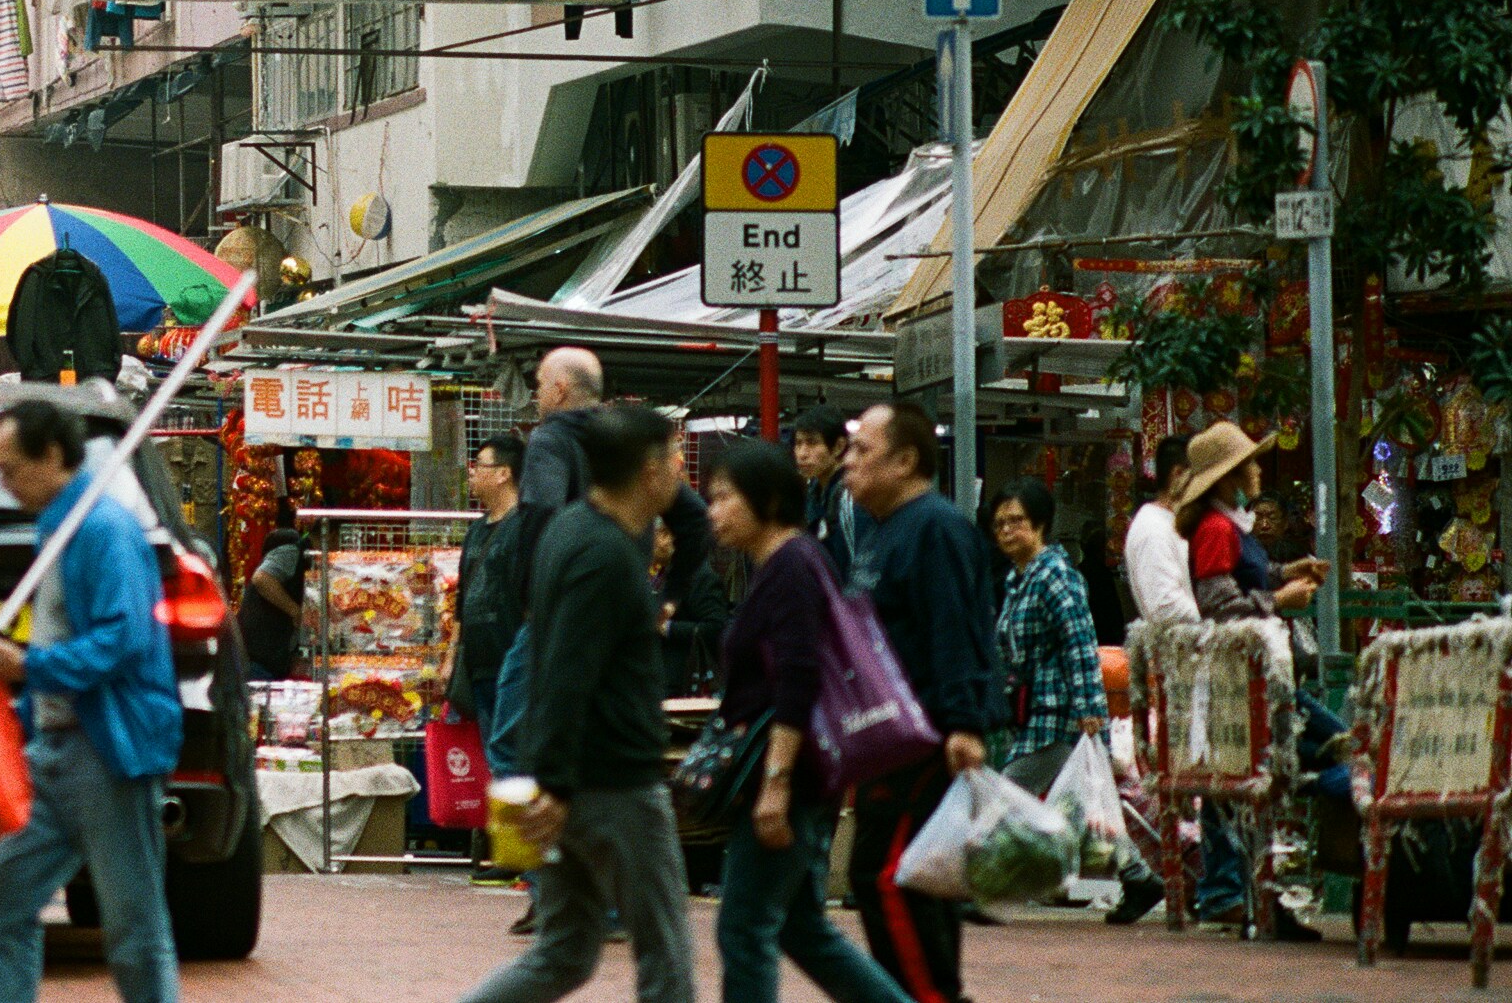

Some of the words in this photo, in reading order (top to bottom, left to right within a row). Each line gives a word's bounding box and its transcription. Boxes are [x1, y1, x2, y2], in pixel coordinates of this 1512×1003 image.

[743, 224, 800, 248] End
[731, 260, 812, 293] 終止
[250, 377, 332, 420] 電話
